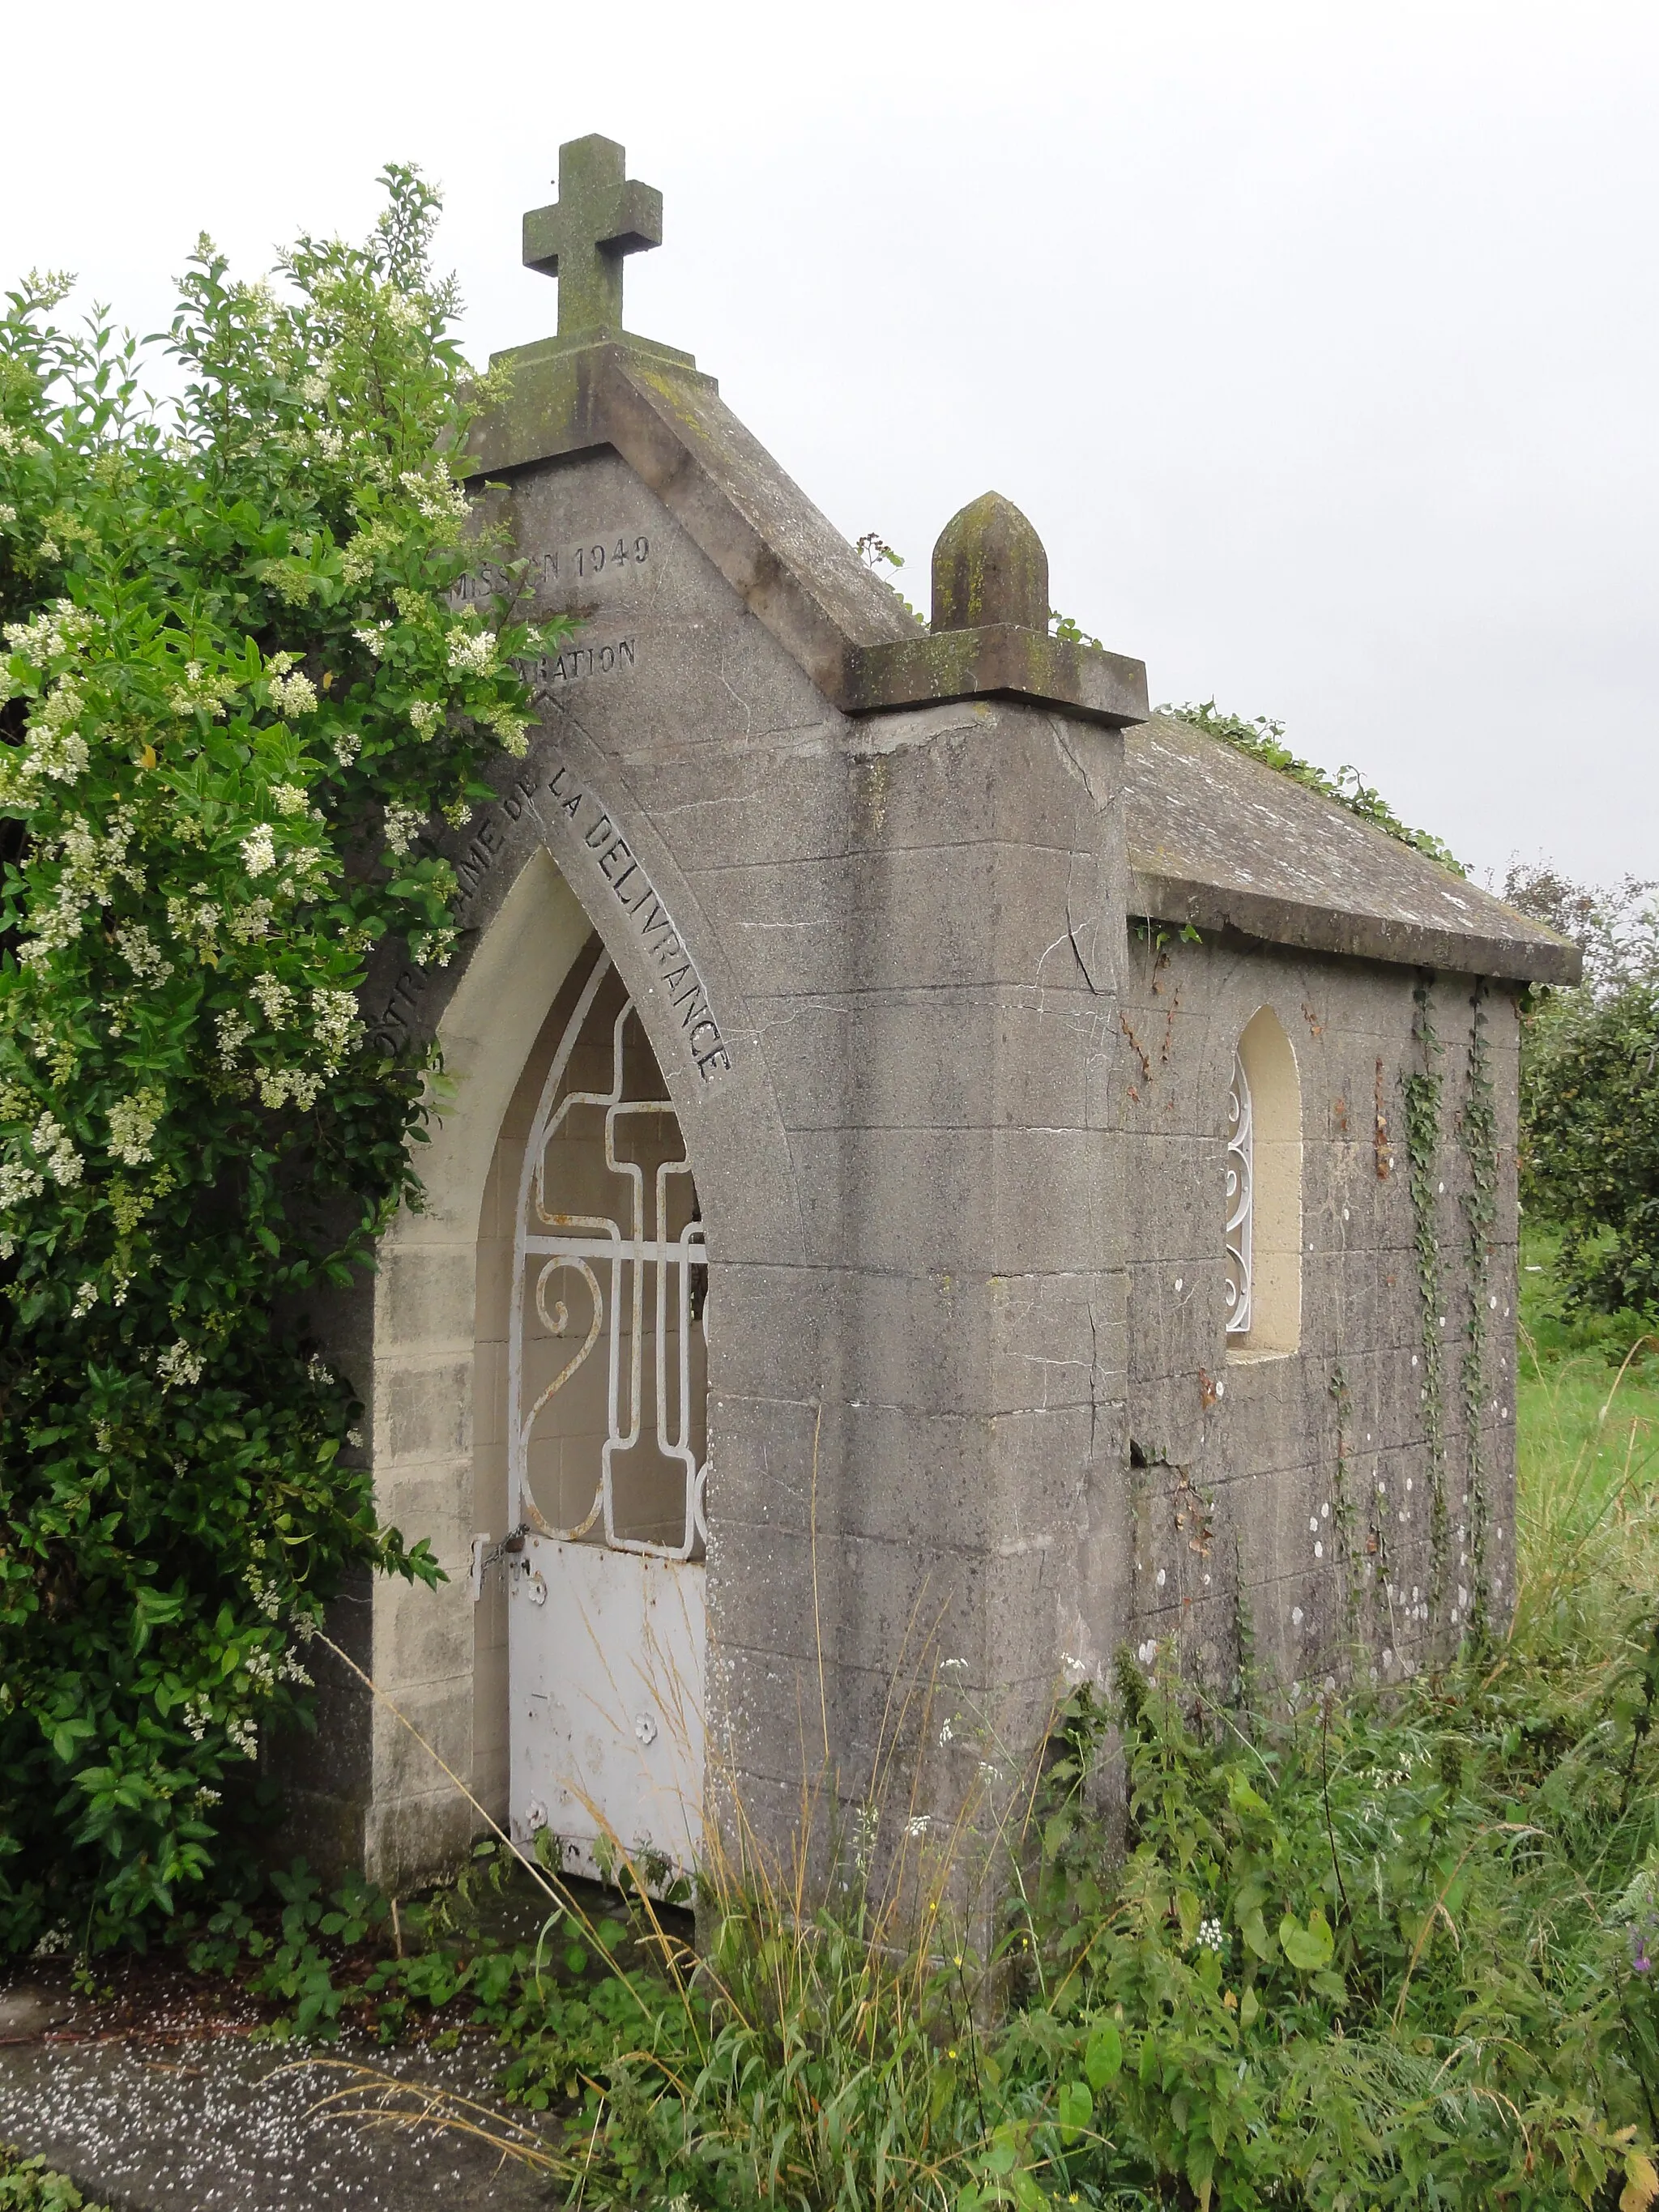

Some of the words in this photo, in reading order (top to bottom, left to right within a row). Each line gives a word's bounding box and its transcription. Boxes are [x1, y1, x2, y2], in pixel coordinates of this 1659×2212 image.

[574, 535, 650, 577] 1949
[502, 774, 539, 821] DE
[547, 767, 584, 819] LA
[583, 814, 731, 1082] DELIVRANCE
